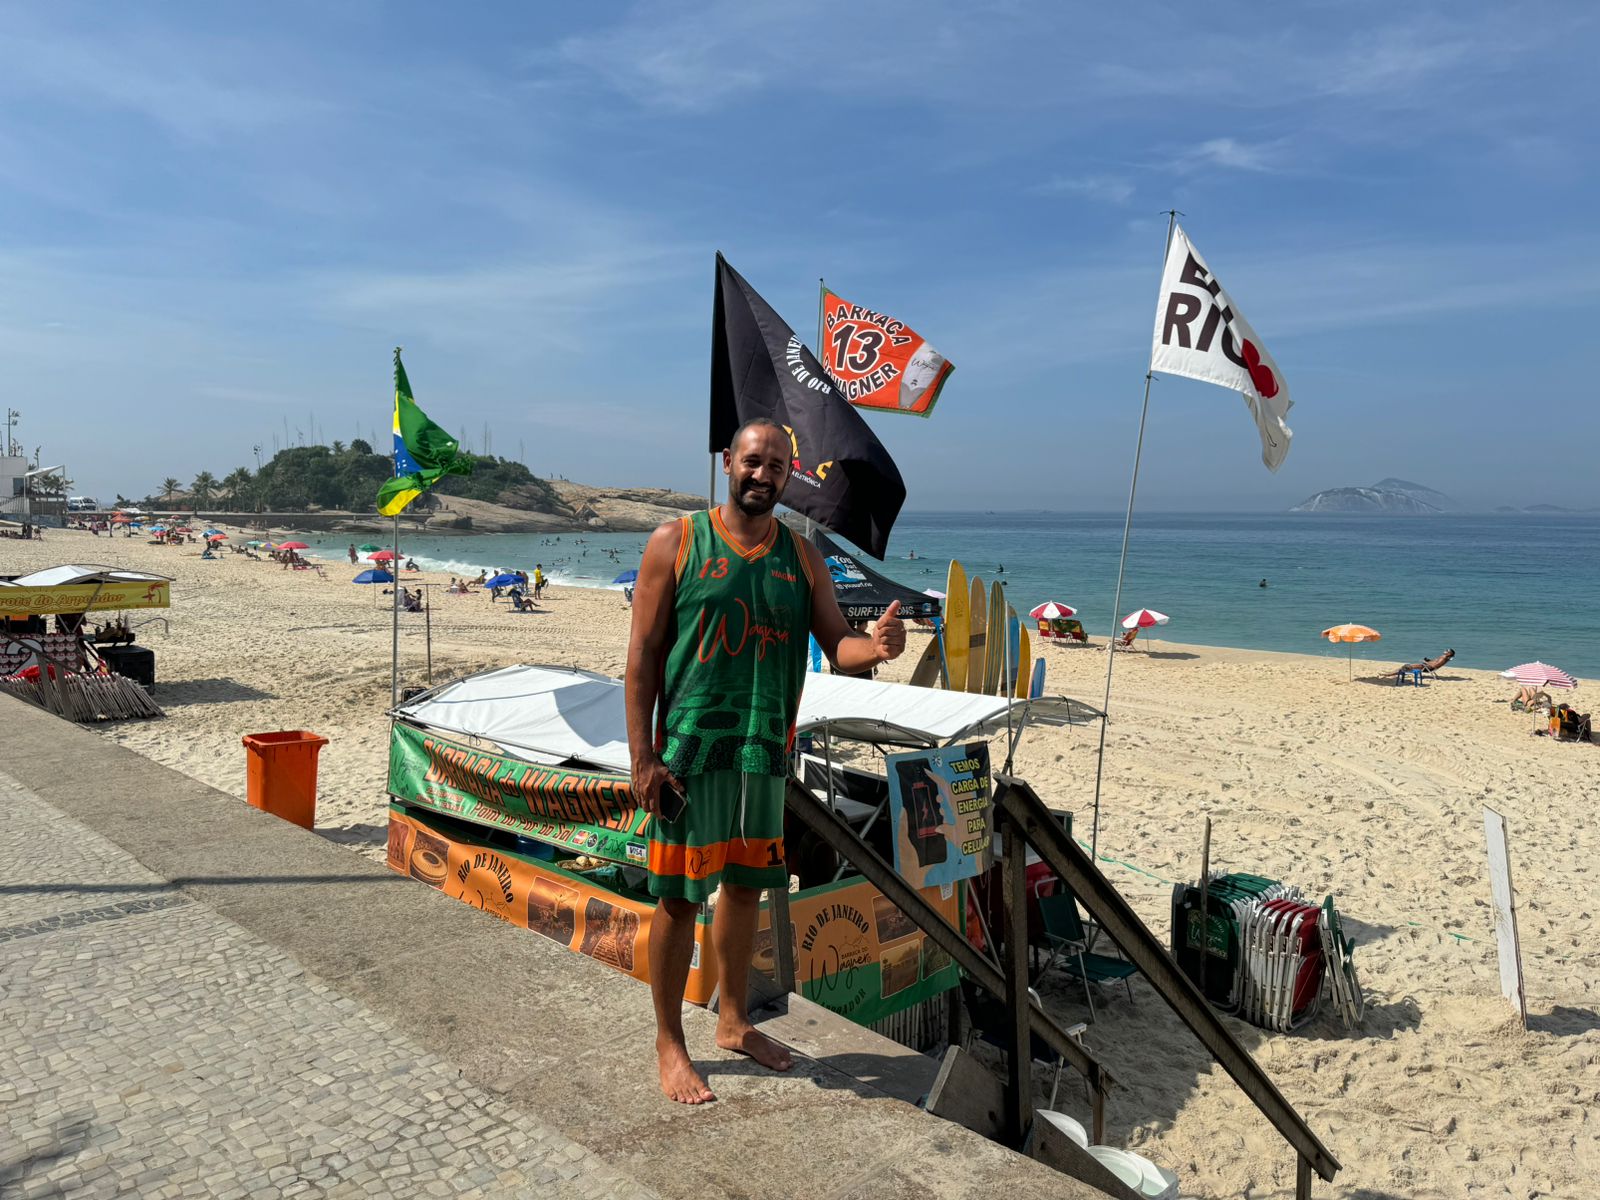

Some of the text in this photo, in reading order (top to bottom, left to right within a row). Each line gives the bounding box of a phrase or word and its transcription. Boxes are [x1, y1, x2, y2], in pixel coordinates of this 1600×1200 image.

[826, 304, 912, 347] BARRACA
[832, 323, 883, 372] 13
[791, 364, 812, 384] DE
[807, 377, 832, 395] RIO
[699, 557, 729, 579] 13
[847, 606, 873, 618] SURF
[874, 605, 915, 617] LEONS
[950, 757, 981, 774] TEMOS
[951, 776, 989, 794] CARGA DE
[519, 767, 639, 834] WAGNER
[957, 797, 989, 814] ENERGIA
[553, 822, 576, 842] Sol
[967, 817, 987, 834] PARA
[629, 846, 643, 857] VISA
[767, 842, 785, 866] 1
[961, 836, 990, 856] CELULAR
[458, 859, 471, 884] RIO
[474, 853, 488, 869] DE
[487, 854, 514, 903] JANEIRO
[801, 903, 869, 952] RIO DE JANEIRO
